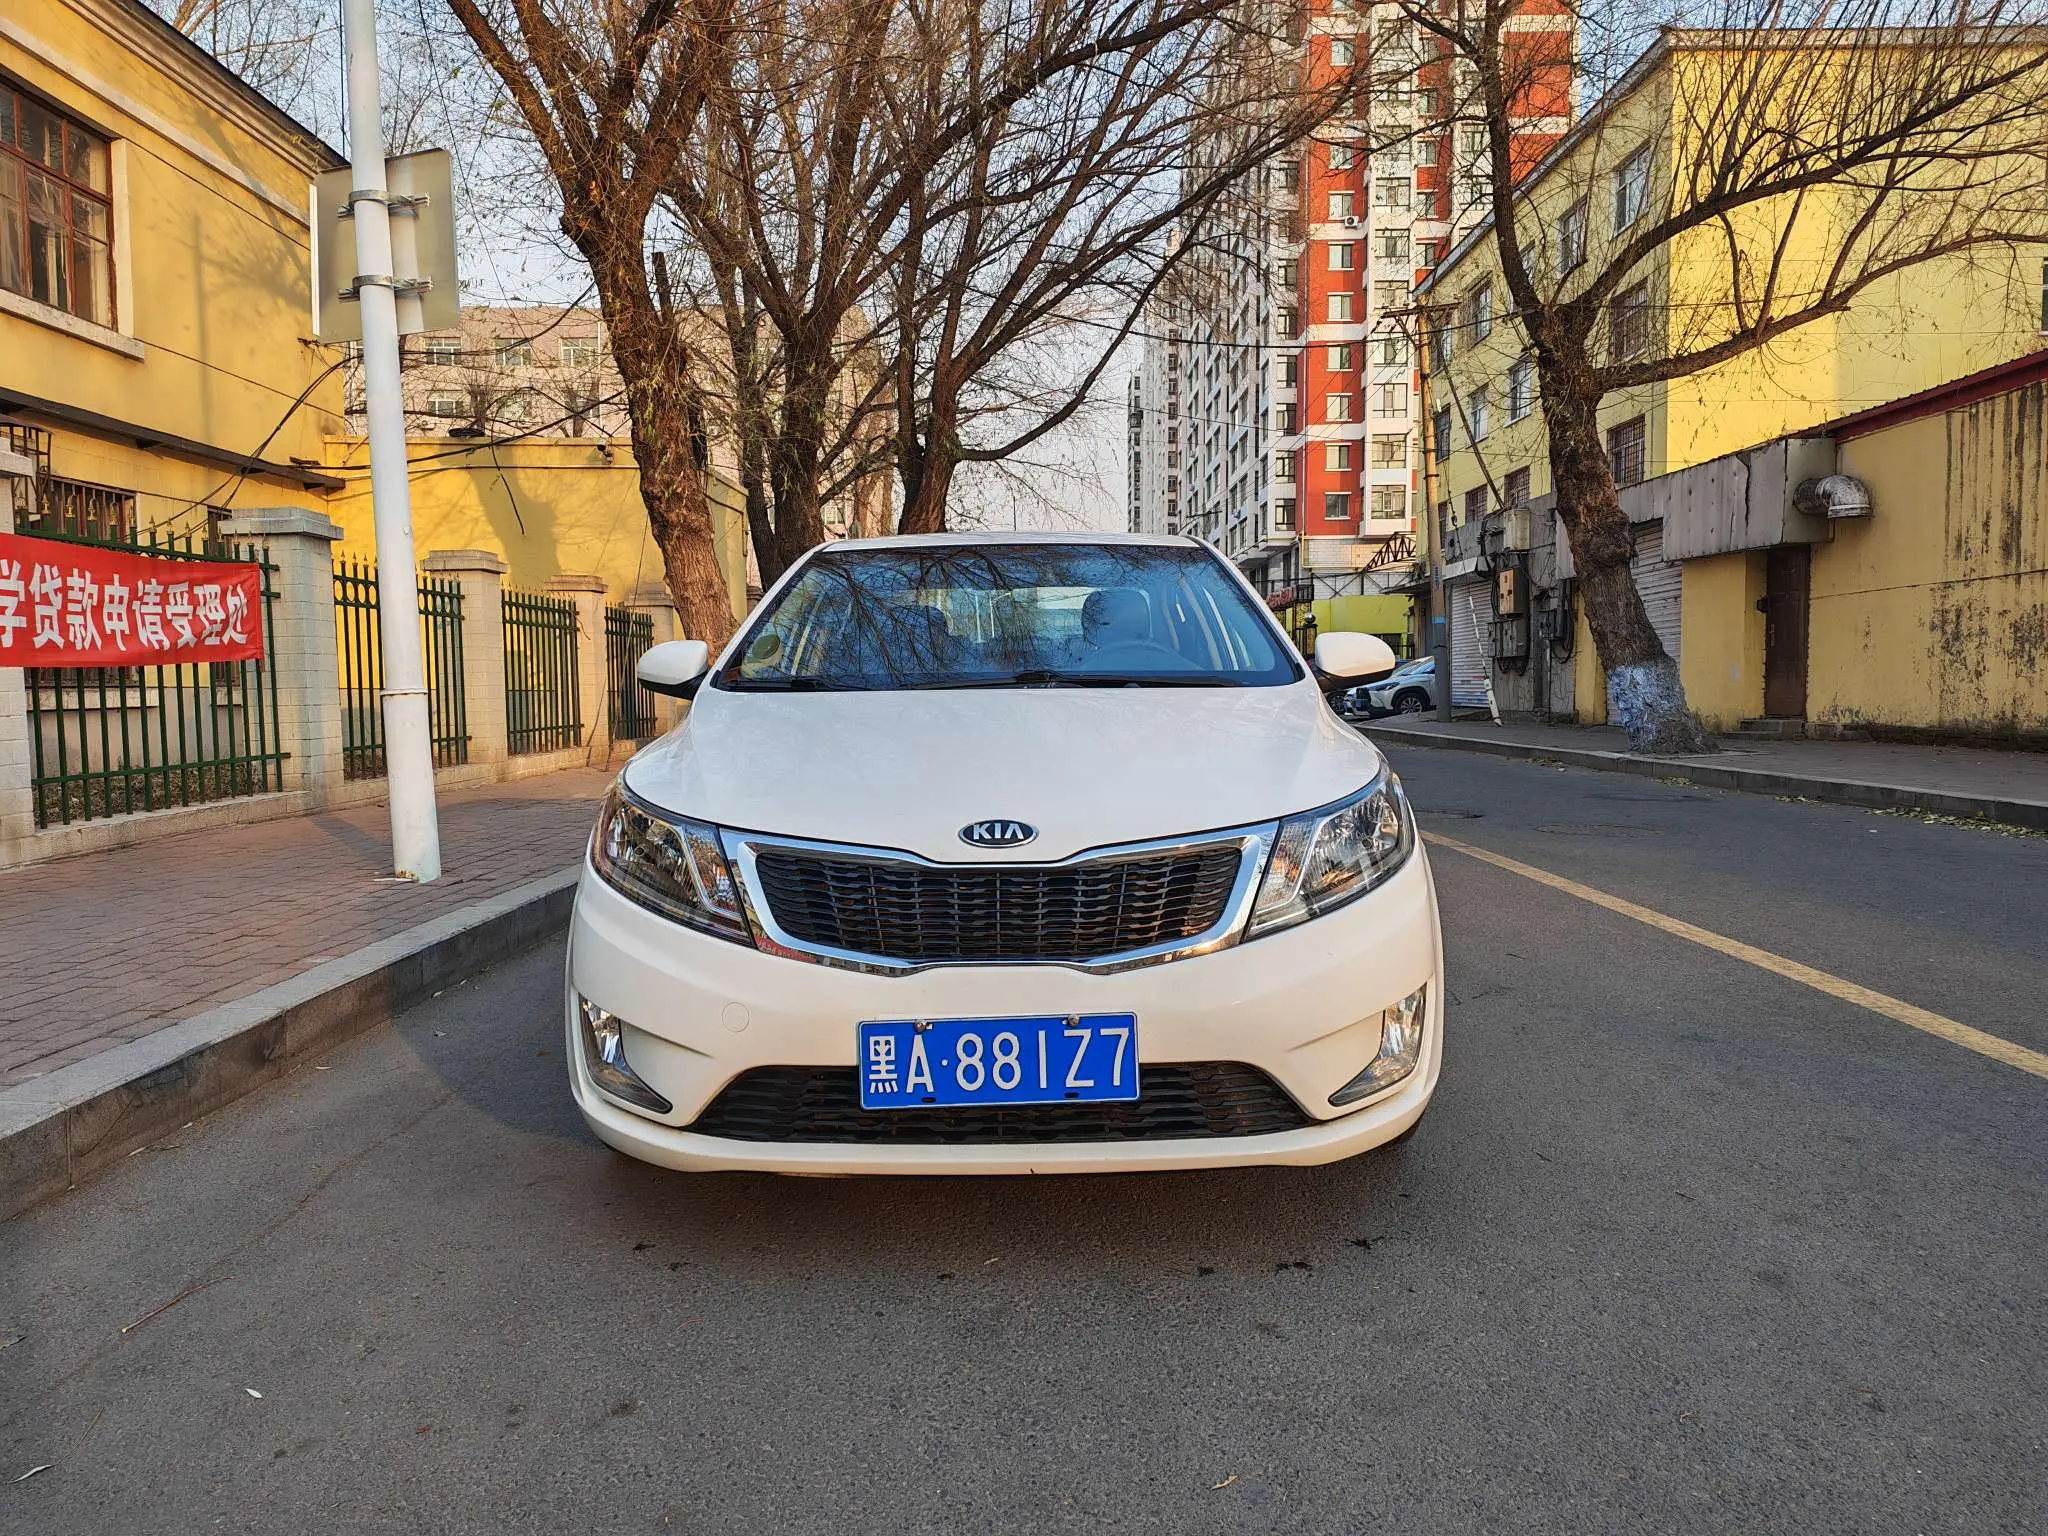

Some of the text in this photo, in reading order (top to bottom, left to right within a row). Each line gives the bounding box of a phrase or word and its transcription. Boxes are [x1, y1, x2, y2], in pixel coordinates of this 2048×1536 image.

[0, 558, 249, 652] 学贷款申请受理处
[972, 822, 1026, 841] KIA
